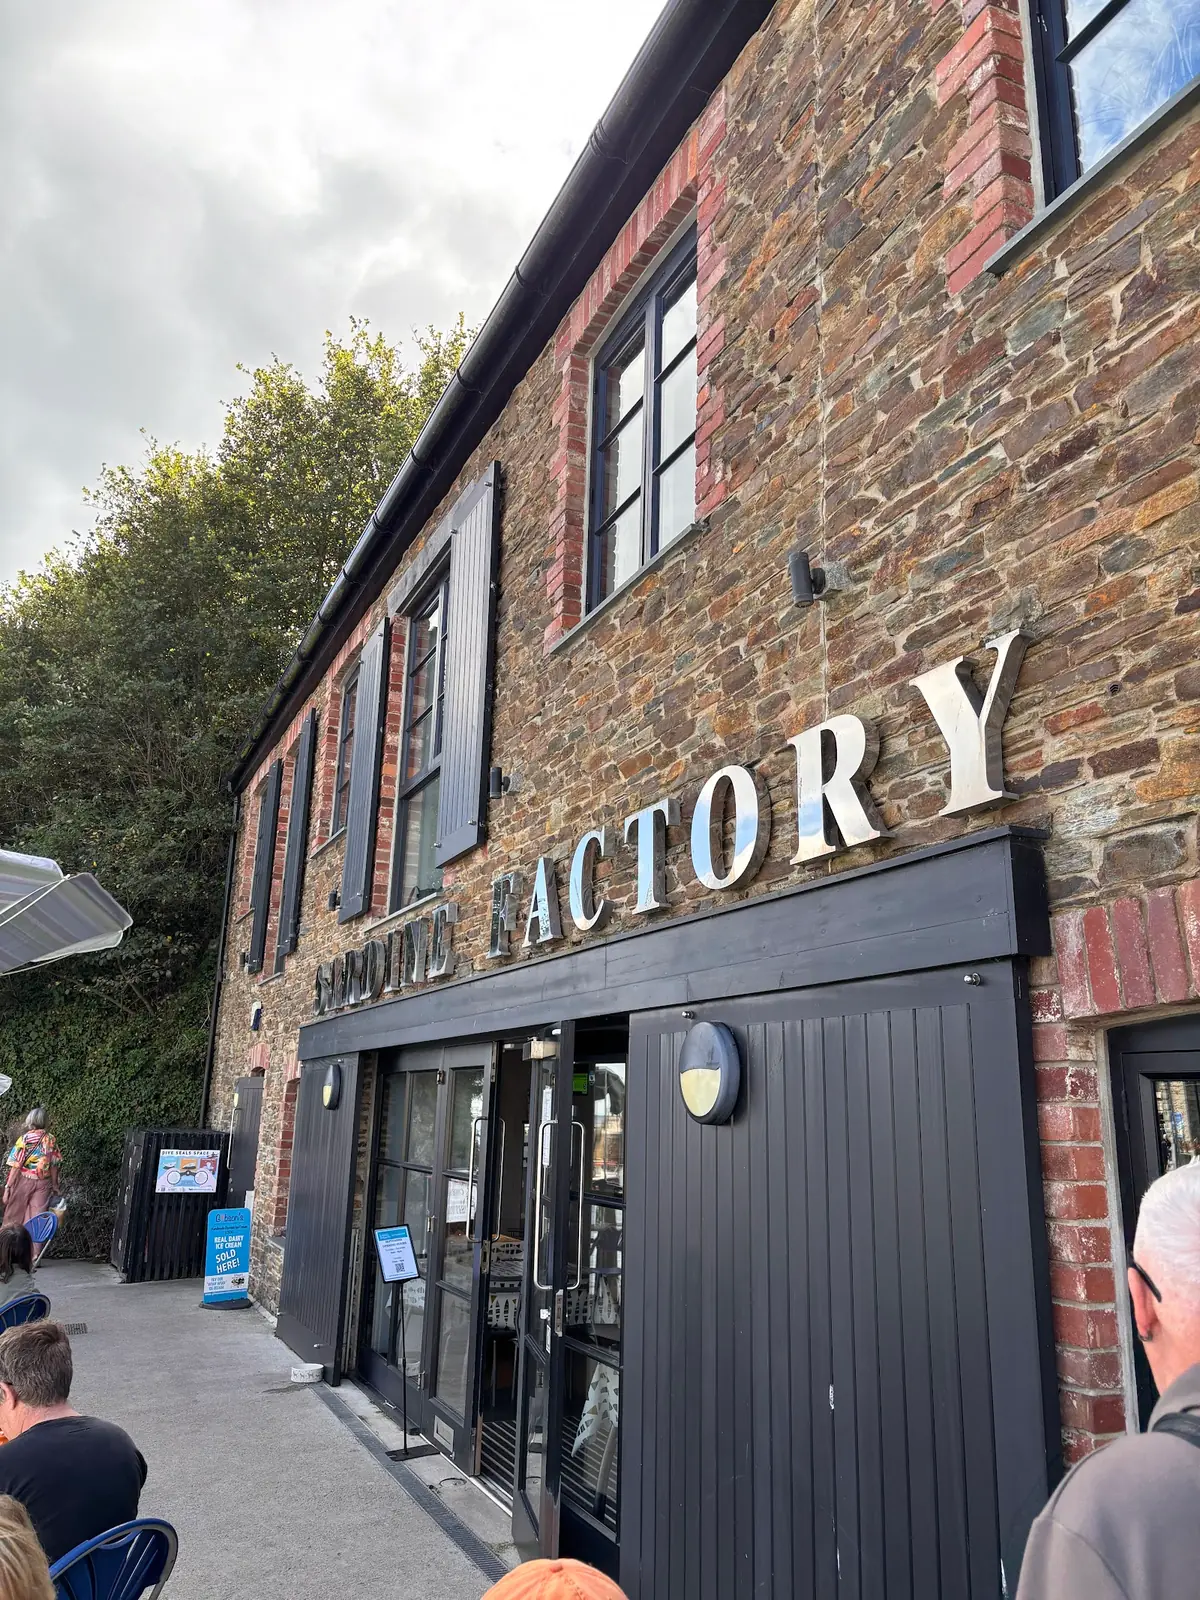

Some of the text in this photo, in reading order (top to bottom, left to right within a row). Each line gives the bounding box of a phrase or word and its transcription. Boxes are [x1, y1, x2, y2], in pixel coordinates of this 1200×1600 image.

[487, 627, 1035, 958] FACTORY
[224, 1241, 242, 1249] CREAM
[215, 1249, 236, 1264] SOLD
[216, 1258, 240, 1274] HERE!
